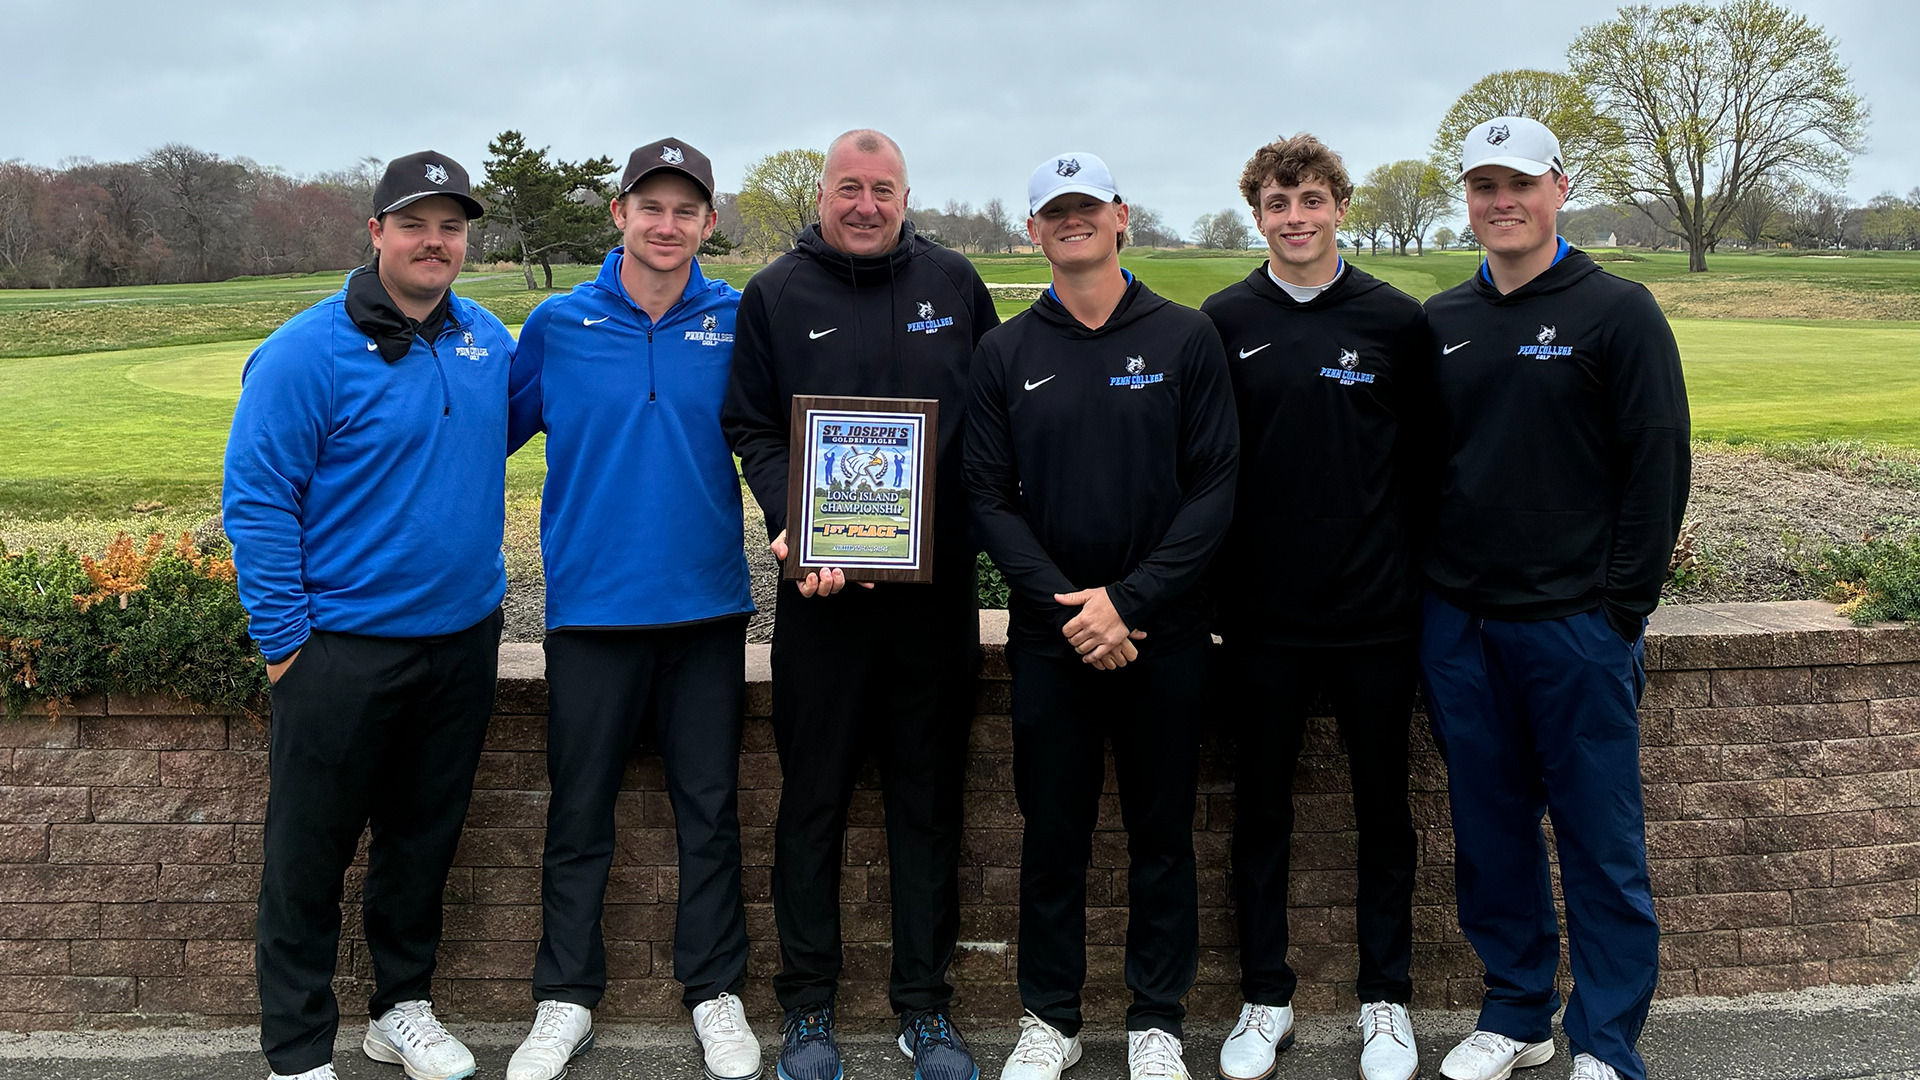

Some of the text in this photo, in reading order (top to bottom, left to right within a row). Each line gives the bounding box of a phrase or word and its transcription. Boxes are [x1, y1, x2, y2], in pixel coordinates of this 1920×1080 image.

[906, 316, 954, 333] PENN COLLEGE
[1109, 372, 1164, 386] PENN COLLEGE
[1320, 366, 1376, 384] PENN COLLEGE
[822, 425, 909, 438] ST. JOSEPH'S
[826, 490, 899, 503] LONG ISLAND
[820, 502, 904, 515] CHAMPIONSHIP
[848, 525, 897, 538] PLACE
